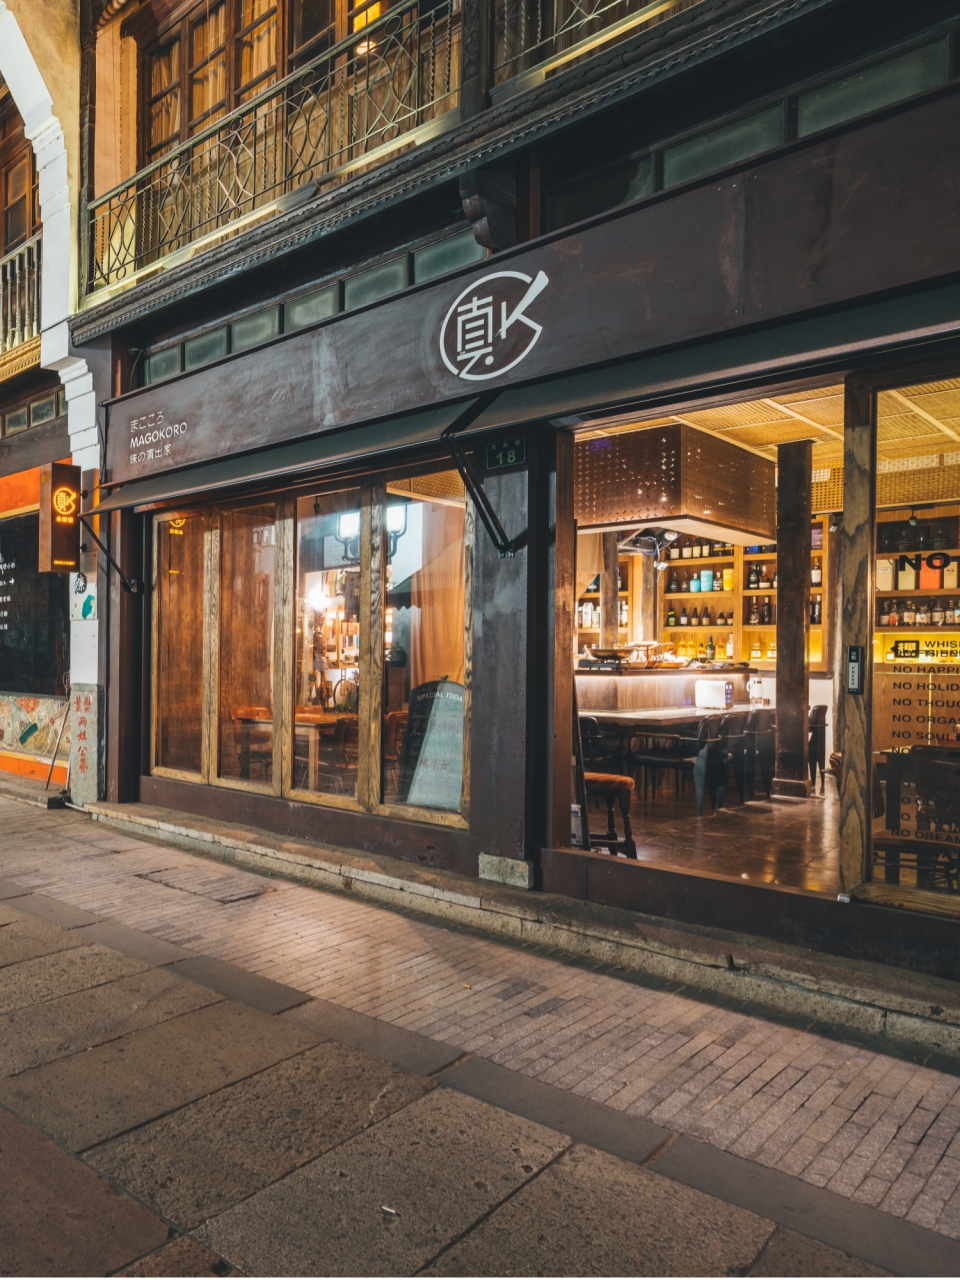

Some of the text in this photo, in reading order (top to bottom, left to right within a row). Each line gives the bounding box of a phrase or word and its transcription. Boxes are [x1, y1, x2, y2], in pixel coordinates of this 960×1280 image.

[130, 422, 187, 449] MAGOKORO
[496, 450, 516, 465] 18
[898, 552, 951, 572] NO
[924, 641, 960, 649] WHIS
[892, 666, 960, 674] NO HAPPI
[892, 682, 960, 691] NO HOLID
[417, 691, 444, 701] SPECIAL
[892, 698, 912, 707] NO
[892, 715, 960, 725] NO ORGA
[892, 731, 953, 741] NO SOUL
[892, 747, 912, 755] NO
[892, 828, 912, 838] NO
